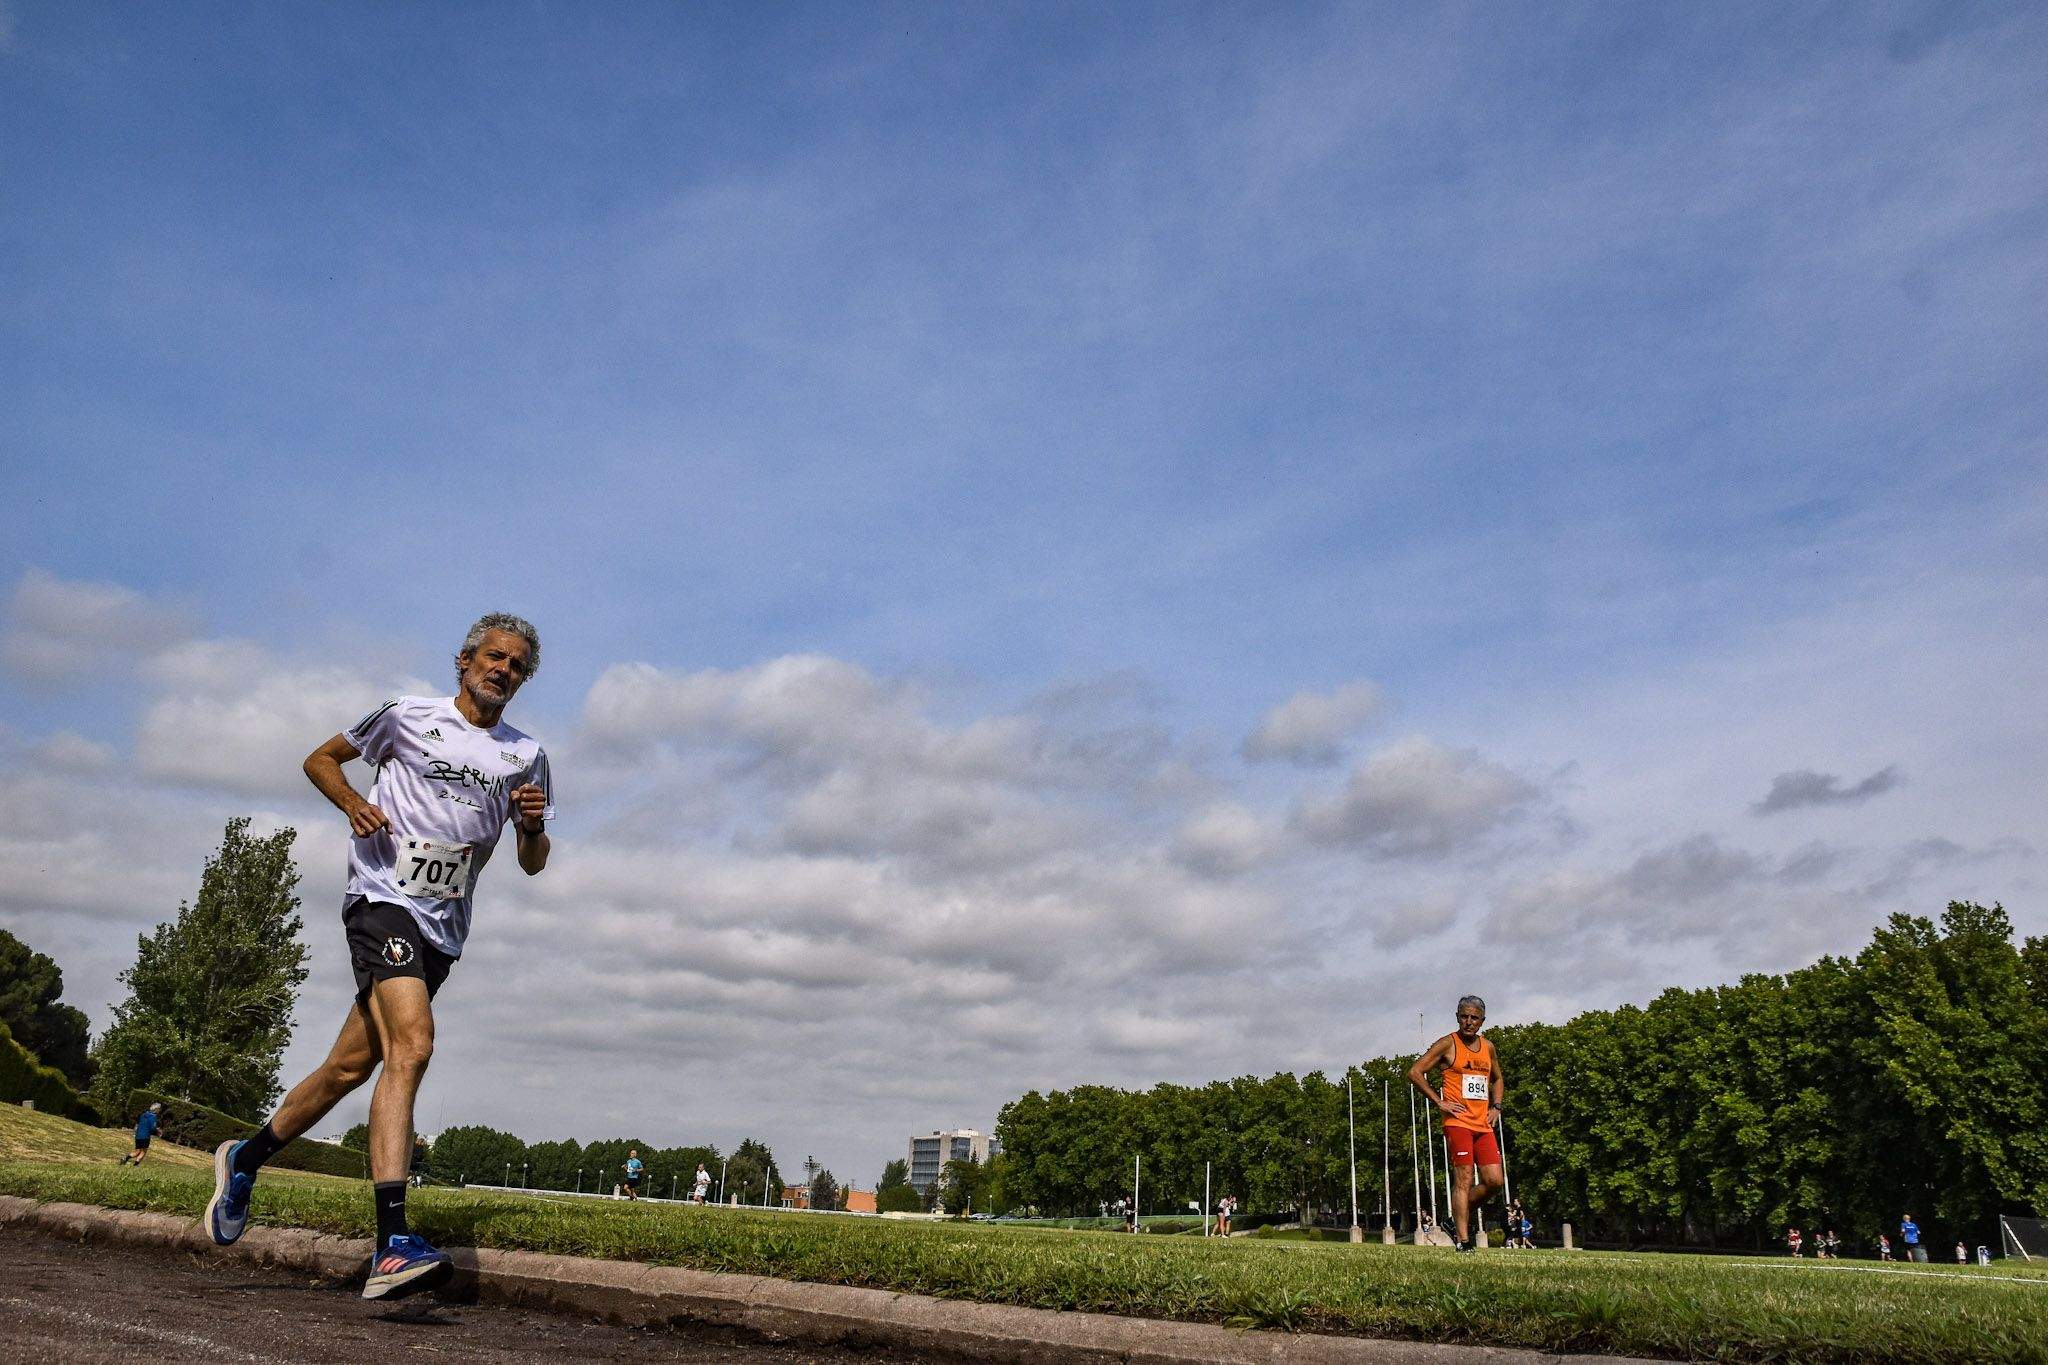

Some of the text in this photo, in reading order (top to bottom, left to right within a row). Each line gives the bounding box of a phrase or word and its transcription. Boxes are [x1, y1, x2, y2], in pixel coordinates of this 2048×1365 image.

[423, 760, 506, 798] BERLIN
[438, 790, 482, 808] 2022
[410, 857, 459, 886] 707
[1468, 1082, 1485, 1093] 894
